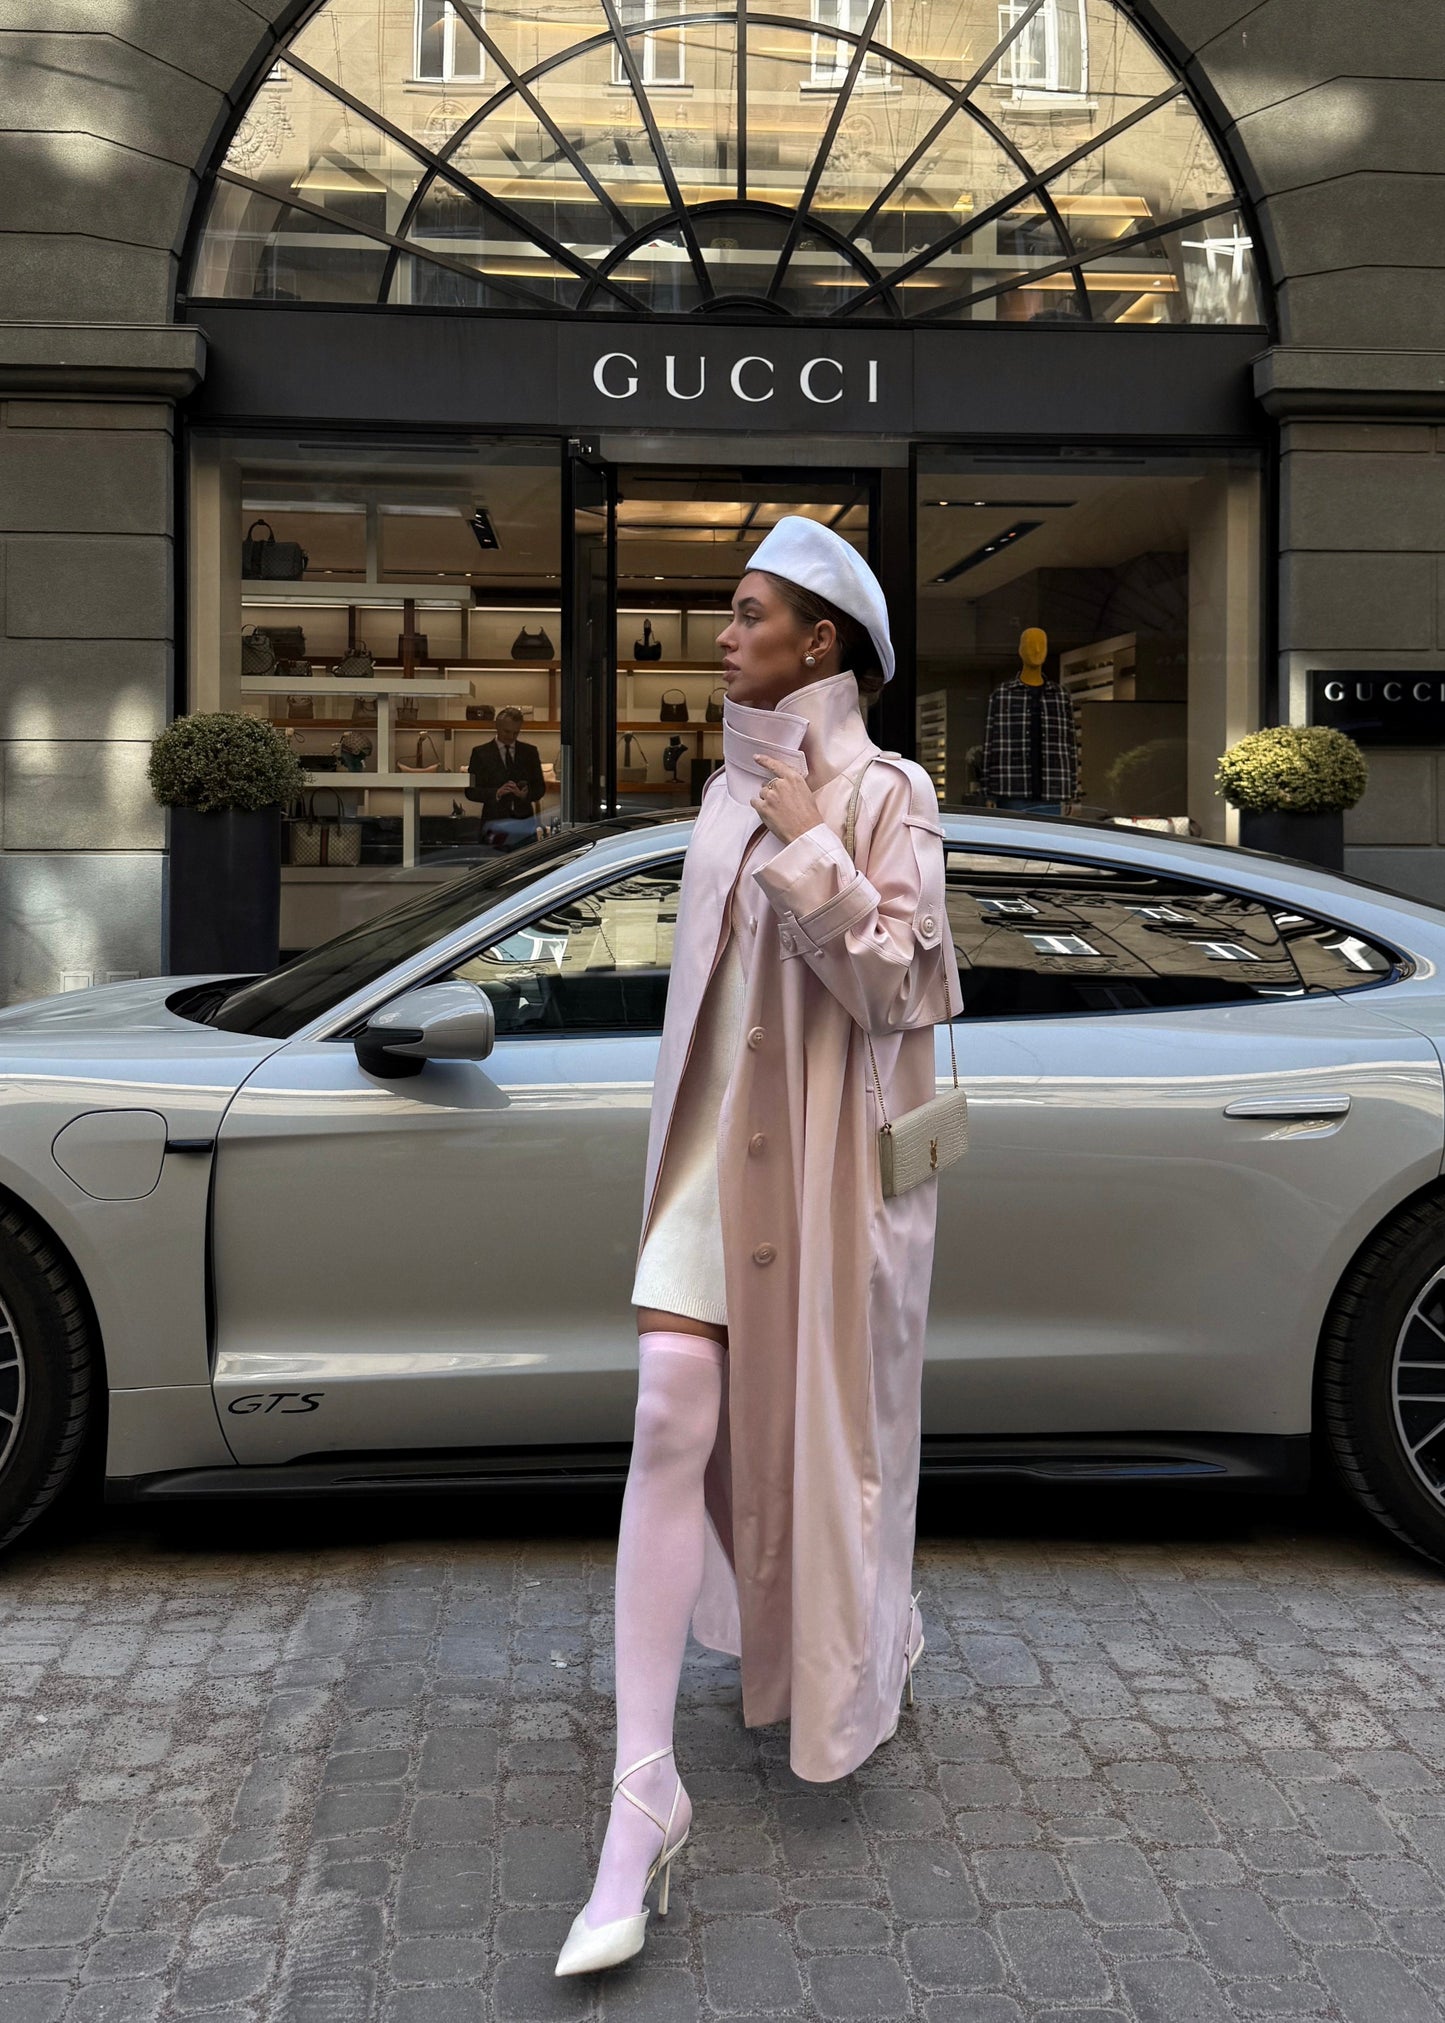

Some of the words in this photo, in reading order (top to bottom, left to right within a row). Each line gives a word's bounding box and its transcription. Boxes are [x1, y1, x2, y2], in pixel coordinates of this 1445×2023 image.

[593, 352, 878, 404] GUCCI
[1324, 681, 1445, 702] GUCCI
[228, 1392, 325, 1415] GTS
